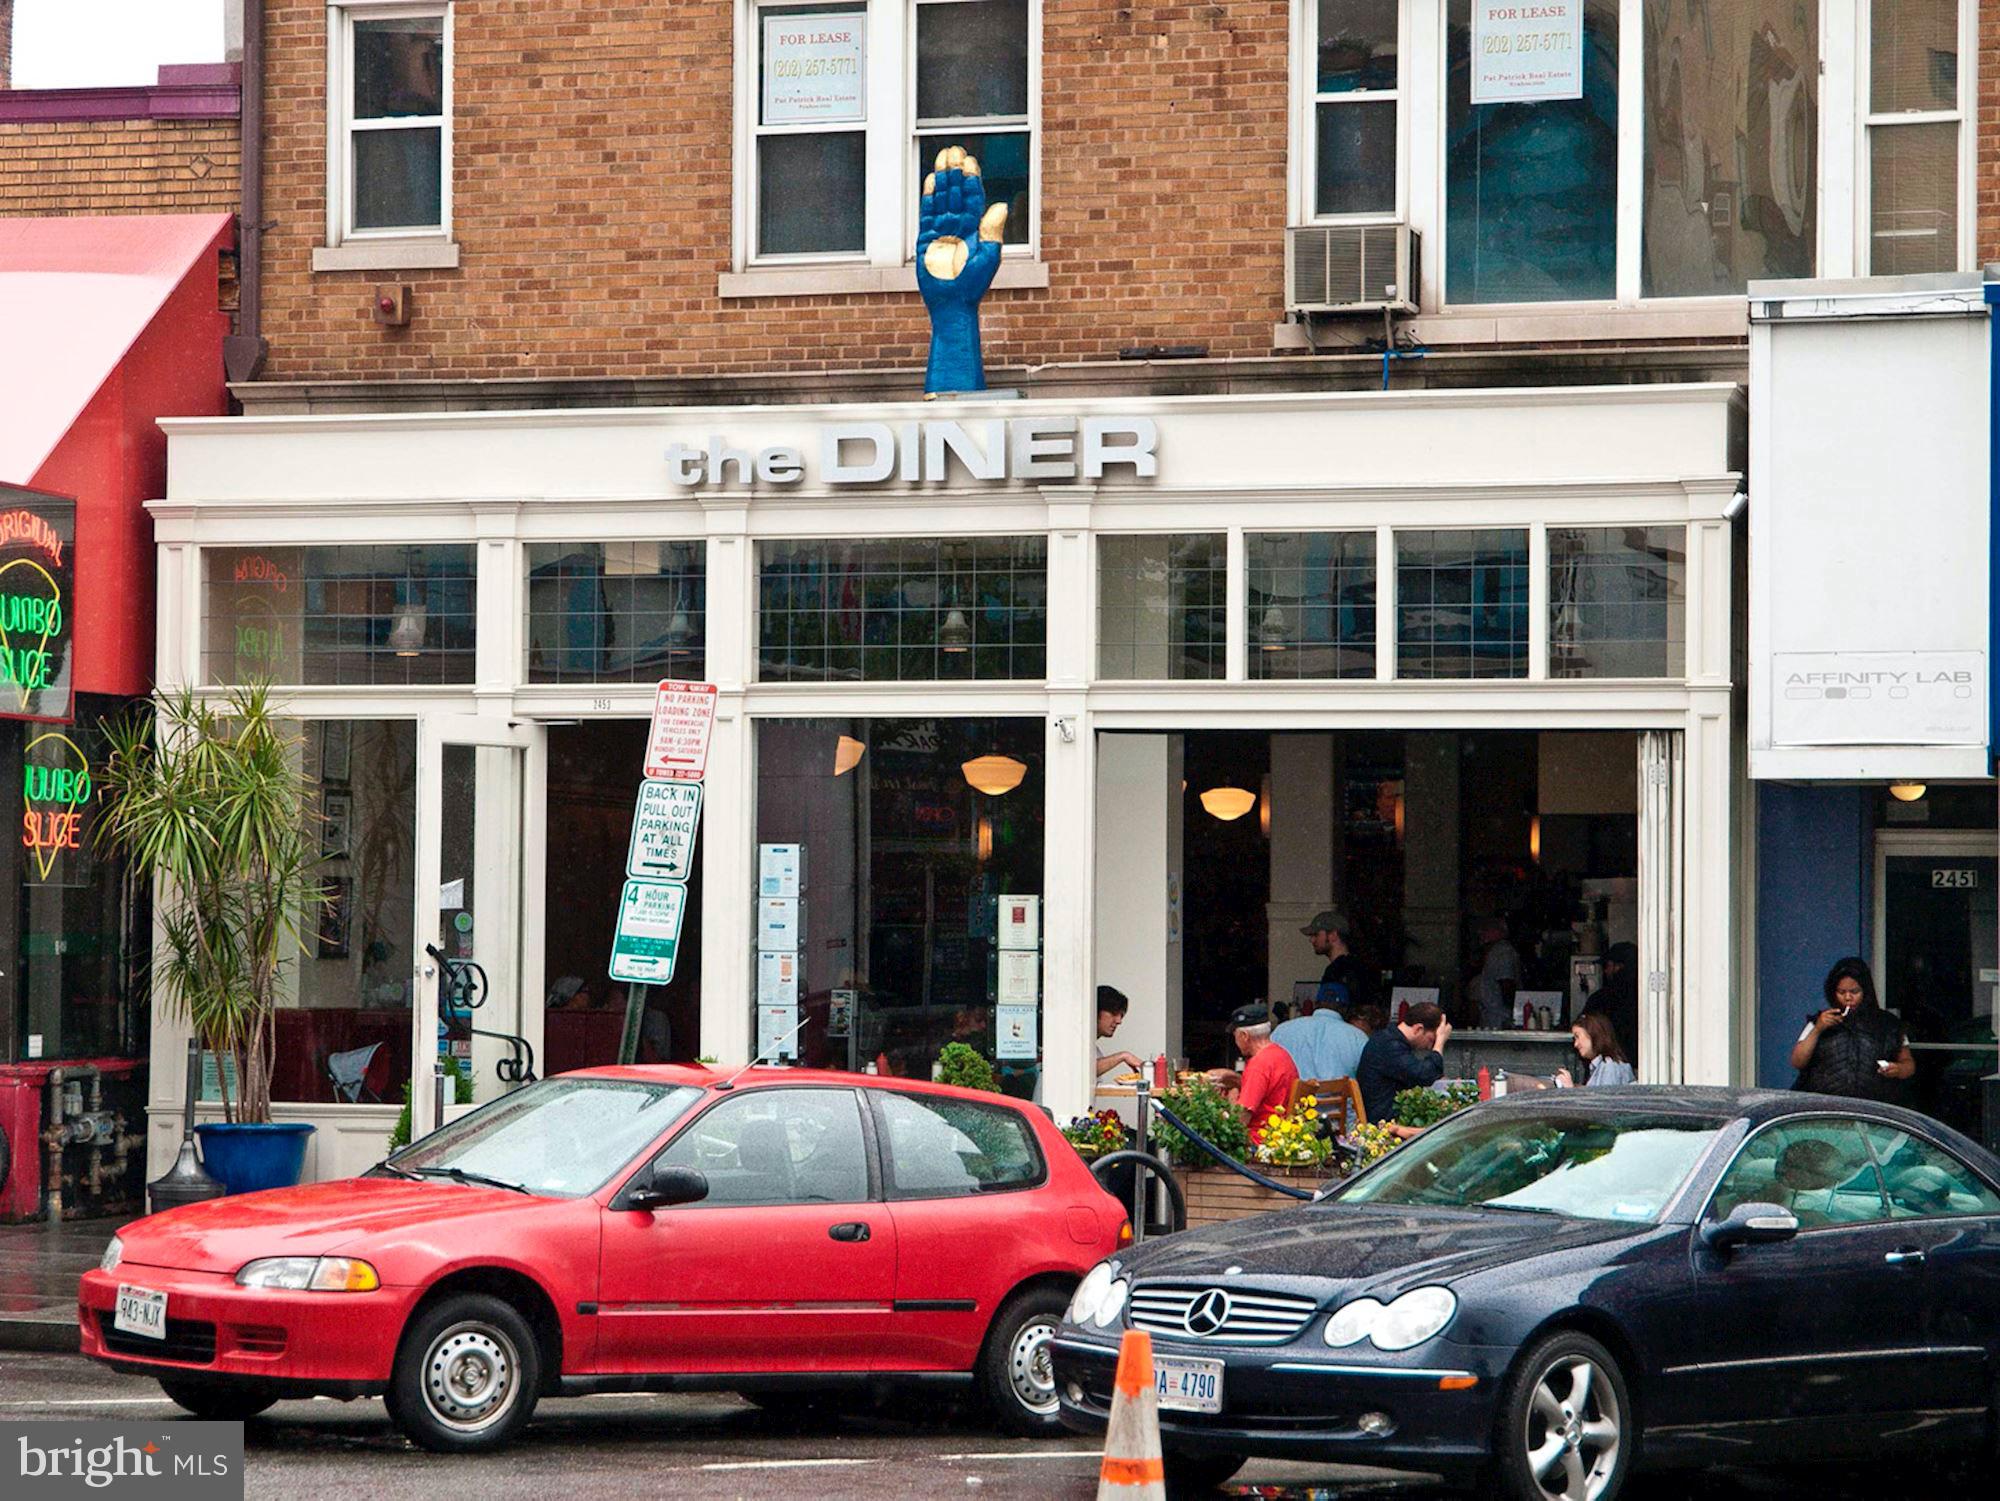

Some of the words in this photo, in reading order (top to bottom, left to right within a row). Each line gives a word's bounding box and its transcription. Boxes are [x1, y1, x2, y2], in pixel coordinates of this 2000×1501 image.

[1488, 9, 1517, 20] FOR
[1521, 6, 1566, 19] LEASE
[780, 34, 806, 45] FOR
[810, 32, 852, 44] LEASE
[1482, 35, 1512, 55] (202)
[1517, 32, 1572, 52] 257-5771
[774, 58, 802, 79] (202)
[805, 57, 857, 76] 257-5771
[665, 436, 805, 486] the
[820, 417, 1160, 484] DINER
[1786, 672, 1908, 684] AFFINITY
[1916, 671, 1973, 684] LAB
[668, 683, 687, 692] TOW
[664, 694, 675, 703] NO
[677, 694, 710, 705] PARKING
[658, 705, 690, 717] LOADING
[692, 707, 711, 718] ZONE
[646, 786, 678, 800] BACK
[683, 790, 697, 802] IN
[643, 803, 667, 816] PULL
[671, 805, 693, 818] OUT
[22, 811, 82, 848] SLICE
[640, 819, 690, 833] PARKING
[641, 833, 656, 844] AT
[661, 834, 684, 846] ALL
[646, 847, 678, 859] TIMES
[1934, 871, 1977, 887] 2451
[628, 885, 639, 905] 4
[645, 890, 670, 901] HOUR
[643, 901, 676, 911] PARKING
[121, 1298, 161, 1328] 943-NJX
[1154, 1370, 1167, 1394] A
[1181, 1372, 1216, 1399] 4790
